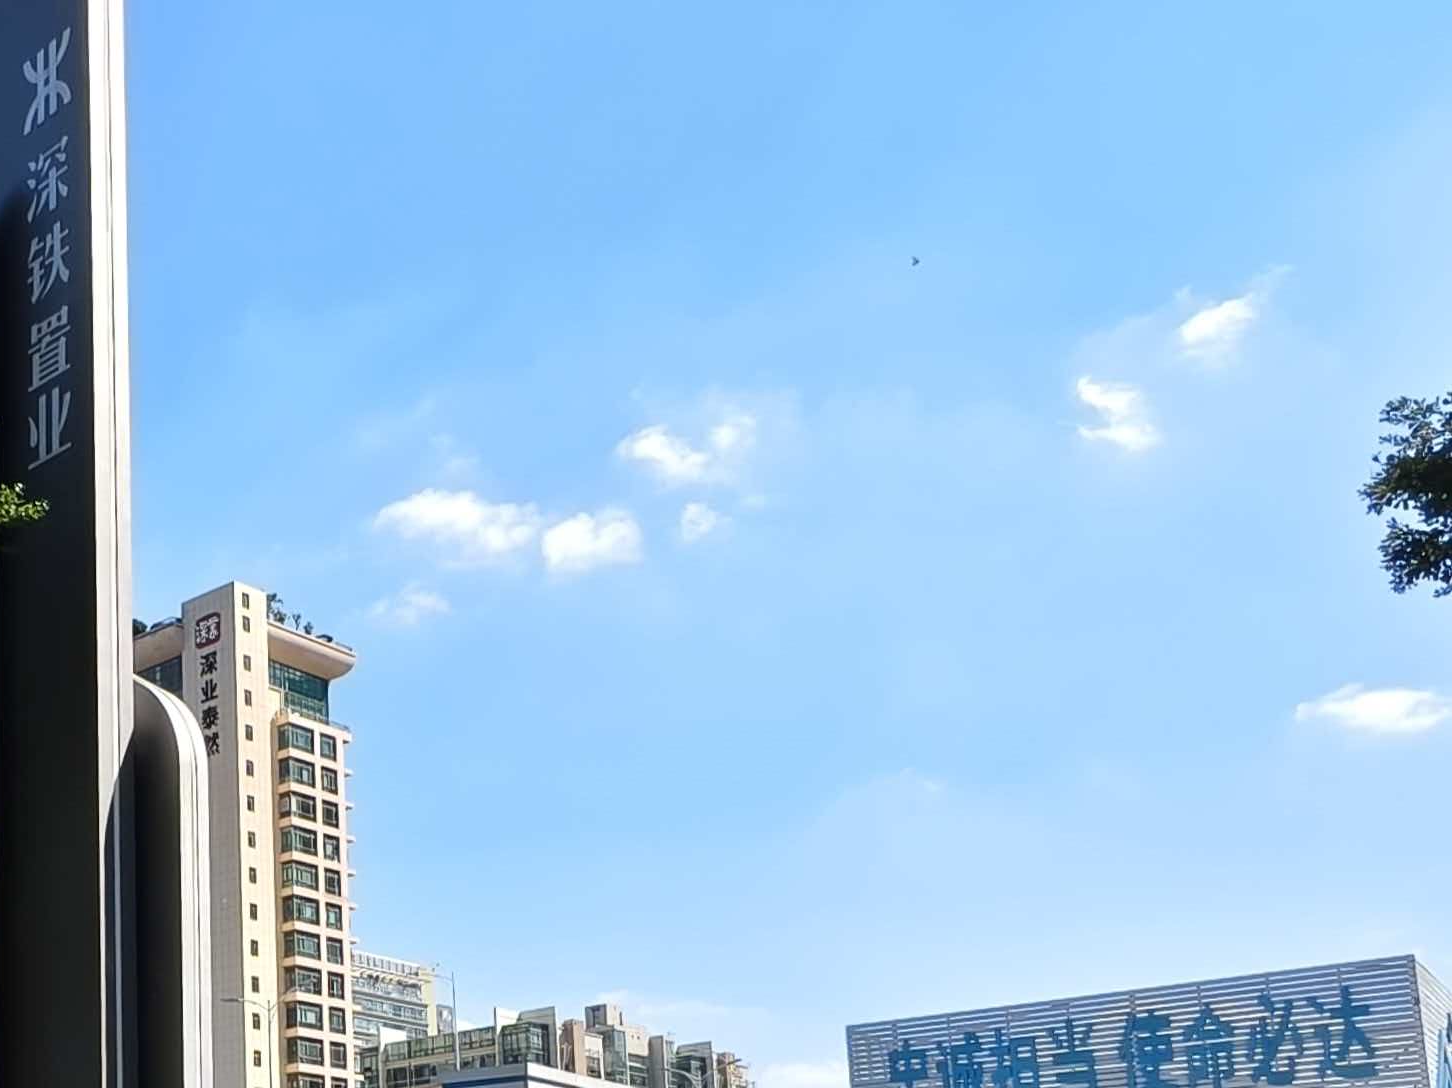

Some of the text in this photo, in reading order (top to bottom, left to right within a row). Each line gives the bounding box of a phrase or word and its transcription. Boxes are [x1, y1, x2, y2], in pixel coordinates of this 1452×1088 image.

[27, 136, 72, 470] 深铁置业
[200, 651, 221, 757] 深业泰然
